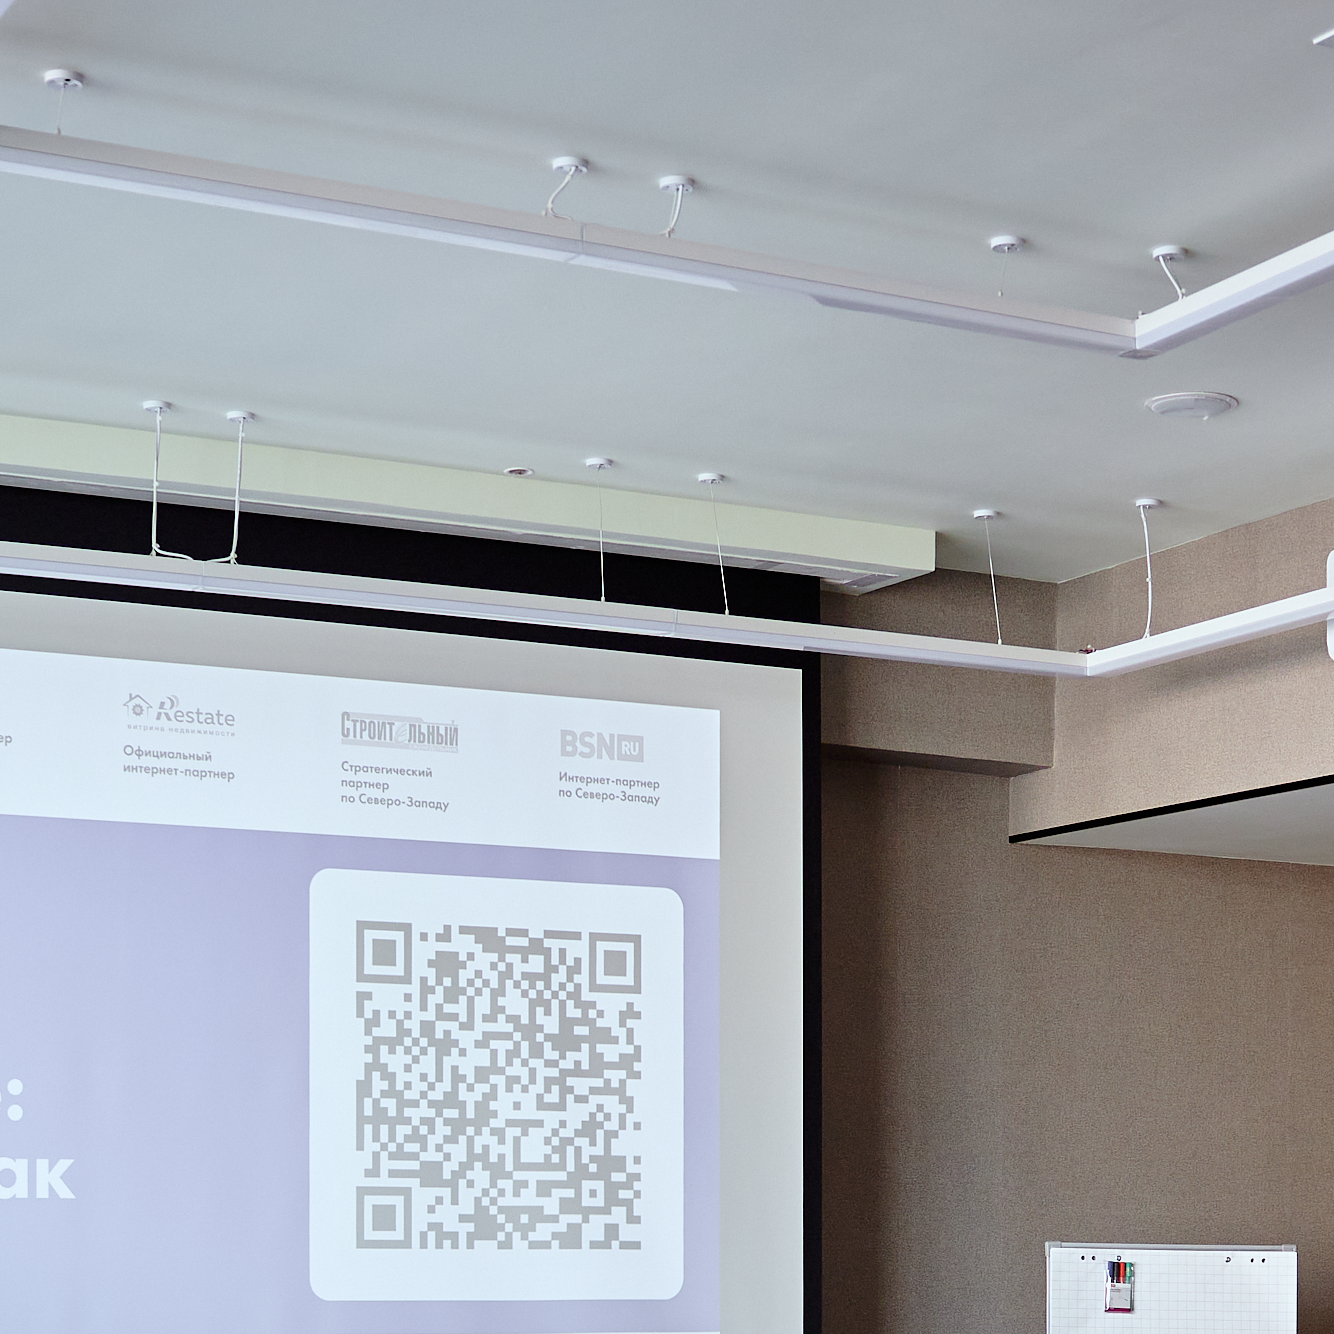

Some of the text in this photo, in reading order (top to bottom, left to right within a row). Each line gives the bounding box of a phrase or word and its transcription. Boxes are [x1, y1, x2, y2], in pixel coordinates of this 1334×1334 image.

[155, 693, 236, 727] Restate
[168, 726, 236, 737] недвижимости
[123, 744, 213, 762] Официальный
[560, 728, 616, 761] BSN
[123, 764, 236, 782] интернет-партнер
[340, 760, 433, 778] Стратегический
[340, 778, 390, 793] партнер
[558, 770, 660, 791] Интернет-партнер
[340, 793, 449, 812] по Северо-Западу
[558, 787, 661, 806] по Северо-Западу
